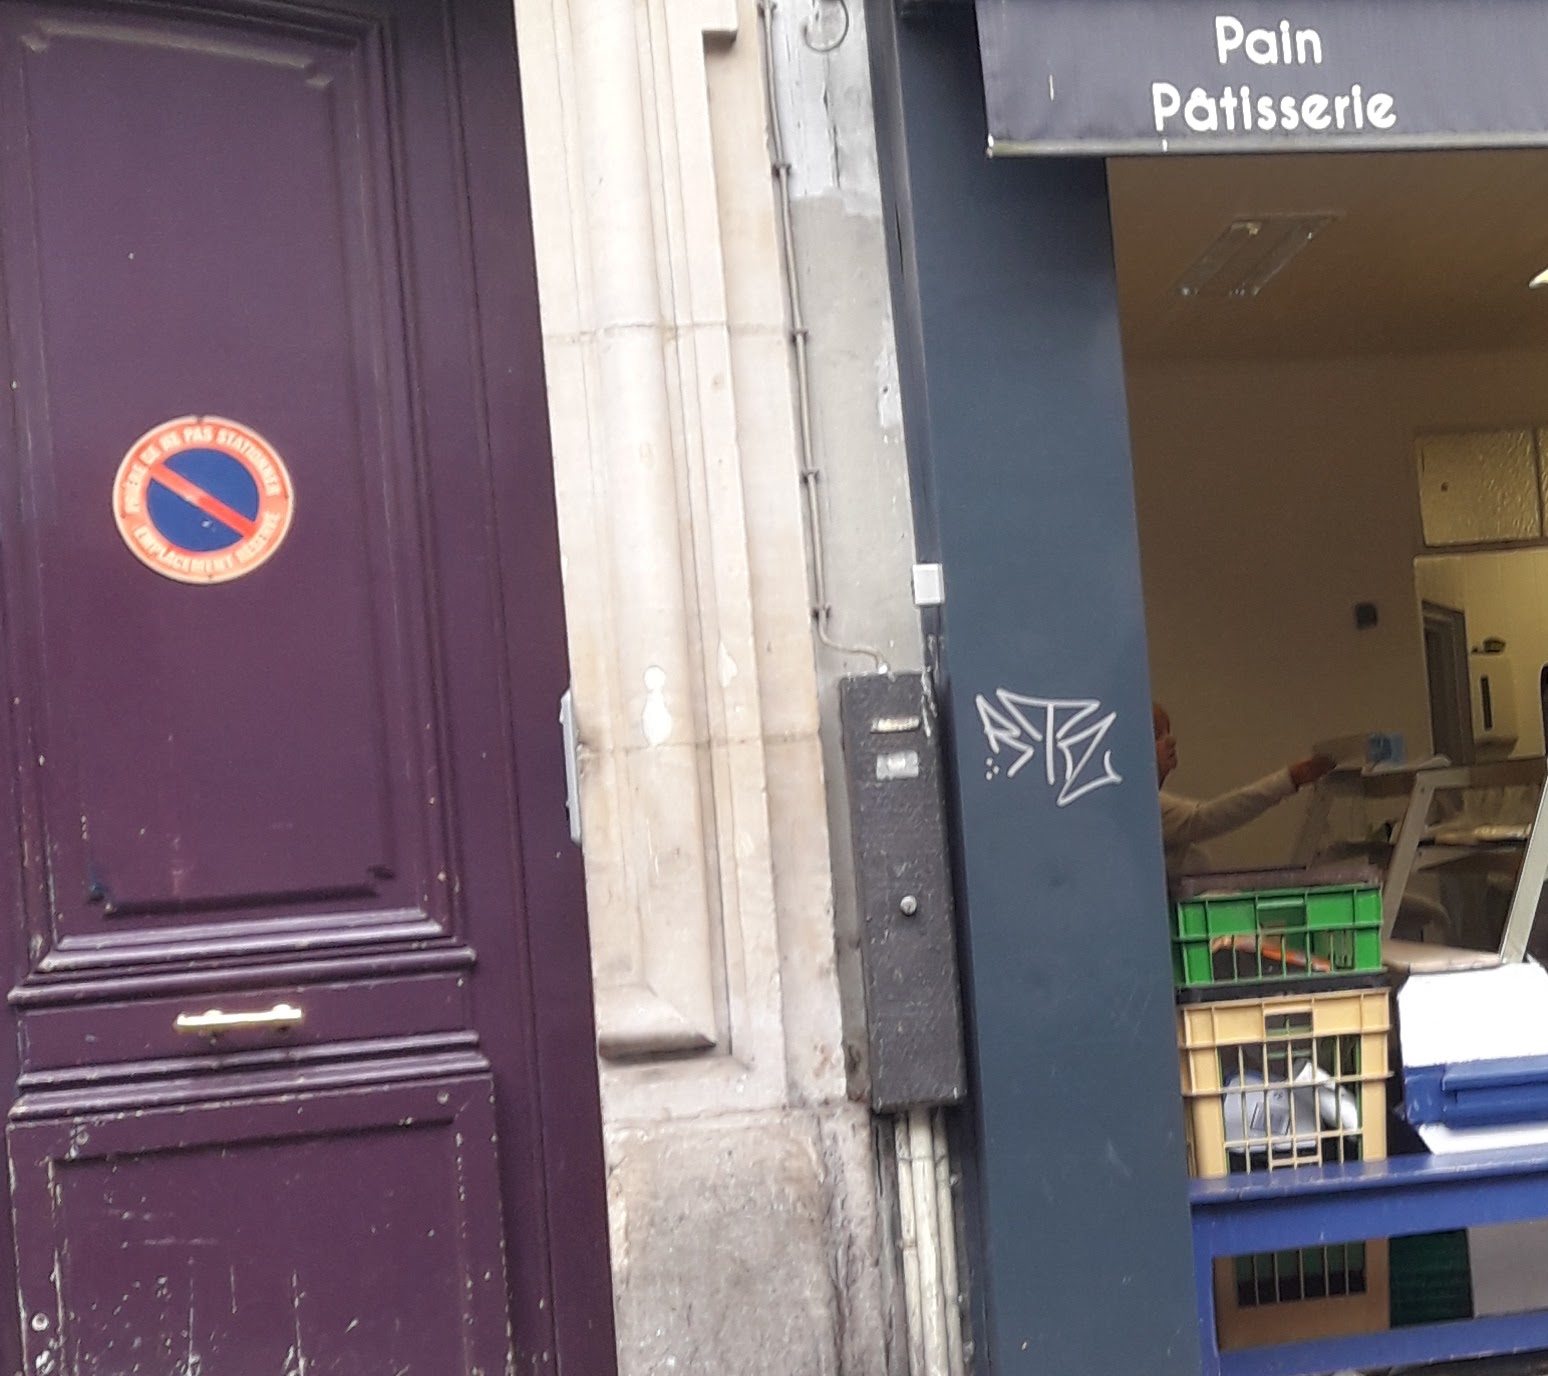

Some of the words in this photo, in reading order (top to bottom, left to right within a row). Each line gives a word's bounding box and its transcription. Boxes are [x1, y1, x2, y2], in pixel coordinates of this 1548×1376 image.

[1215, 15, 1322, 65] Pain
[1152, 82, 1397, 131] Pâtisserie
[183, 425, 214, 443] PAS
